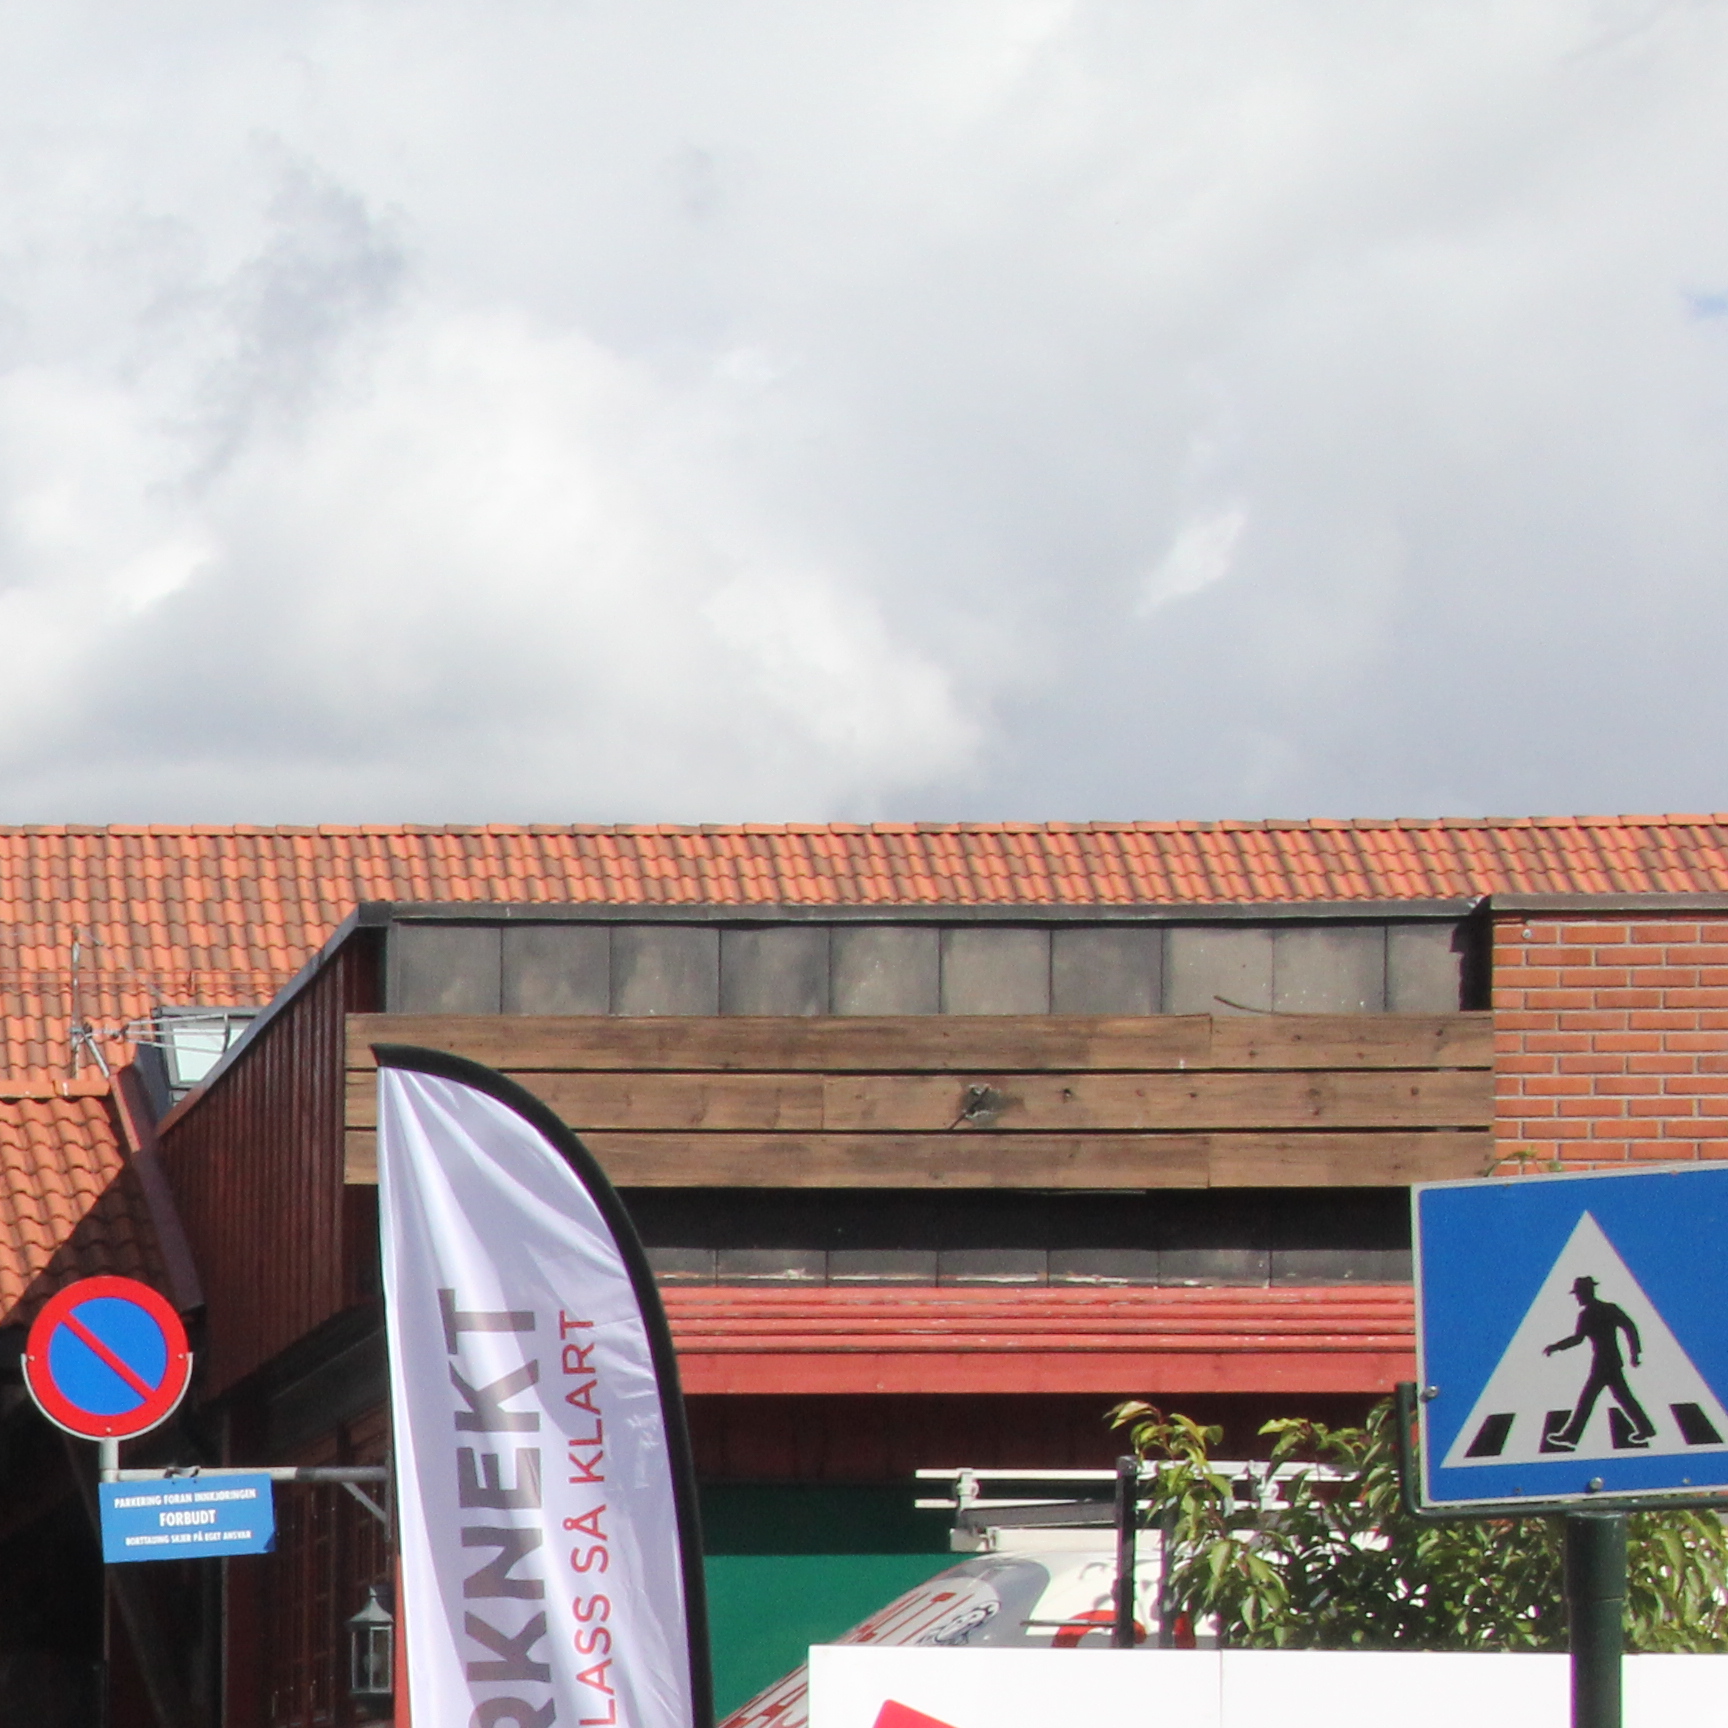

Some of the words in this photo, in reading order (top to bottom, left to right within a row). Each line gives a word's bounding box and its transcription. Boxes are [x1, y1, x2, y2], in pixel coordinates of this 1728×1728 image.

[560, 1310, 606, 1484] KLART
[114, 1494, 162, 1509] PARKERING
[163, 1492, 193, 1505] FORAN
[159, 1509, 217, 1527] FORBUDT
[171, 1533, 192, 1545] SKJER
[193, 1530, 204, 1542] PÅ
[223, 1530, 252, 1541] ANSVAR
[563, 1504, 611, 1574] SÅ
